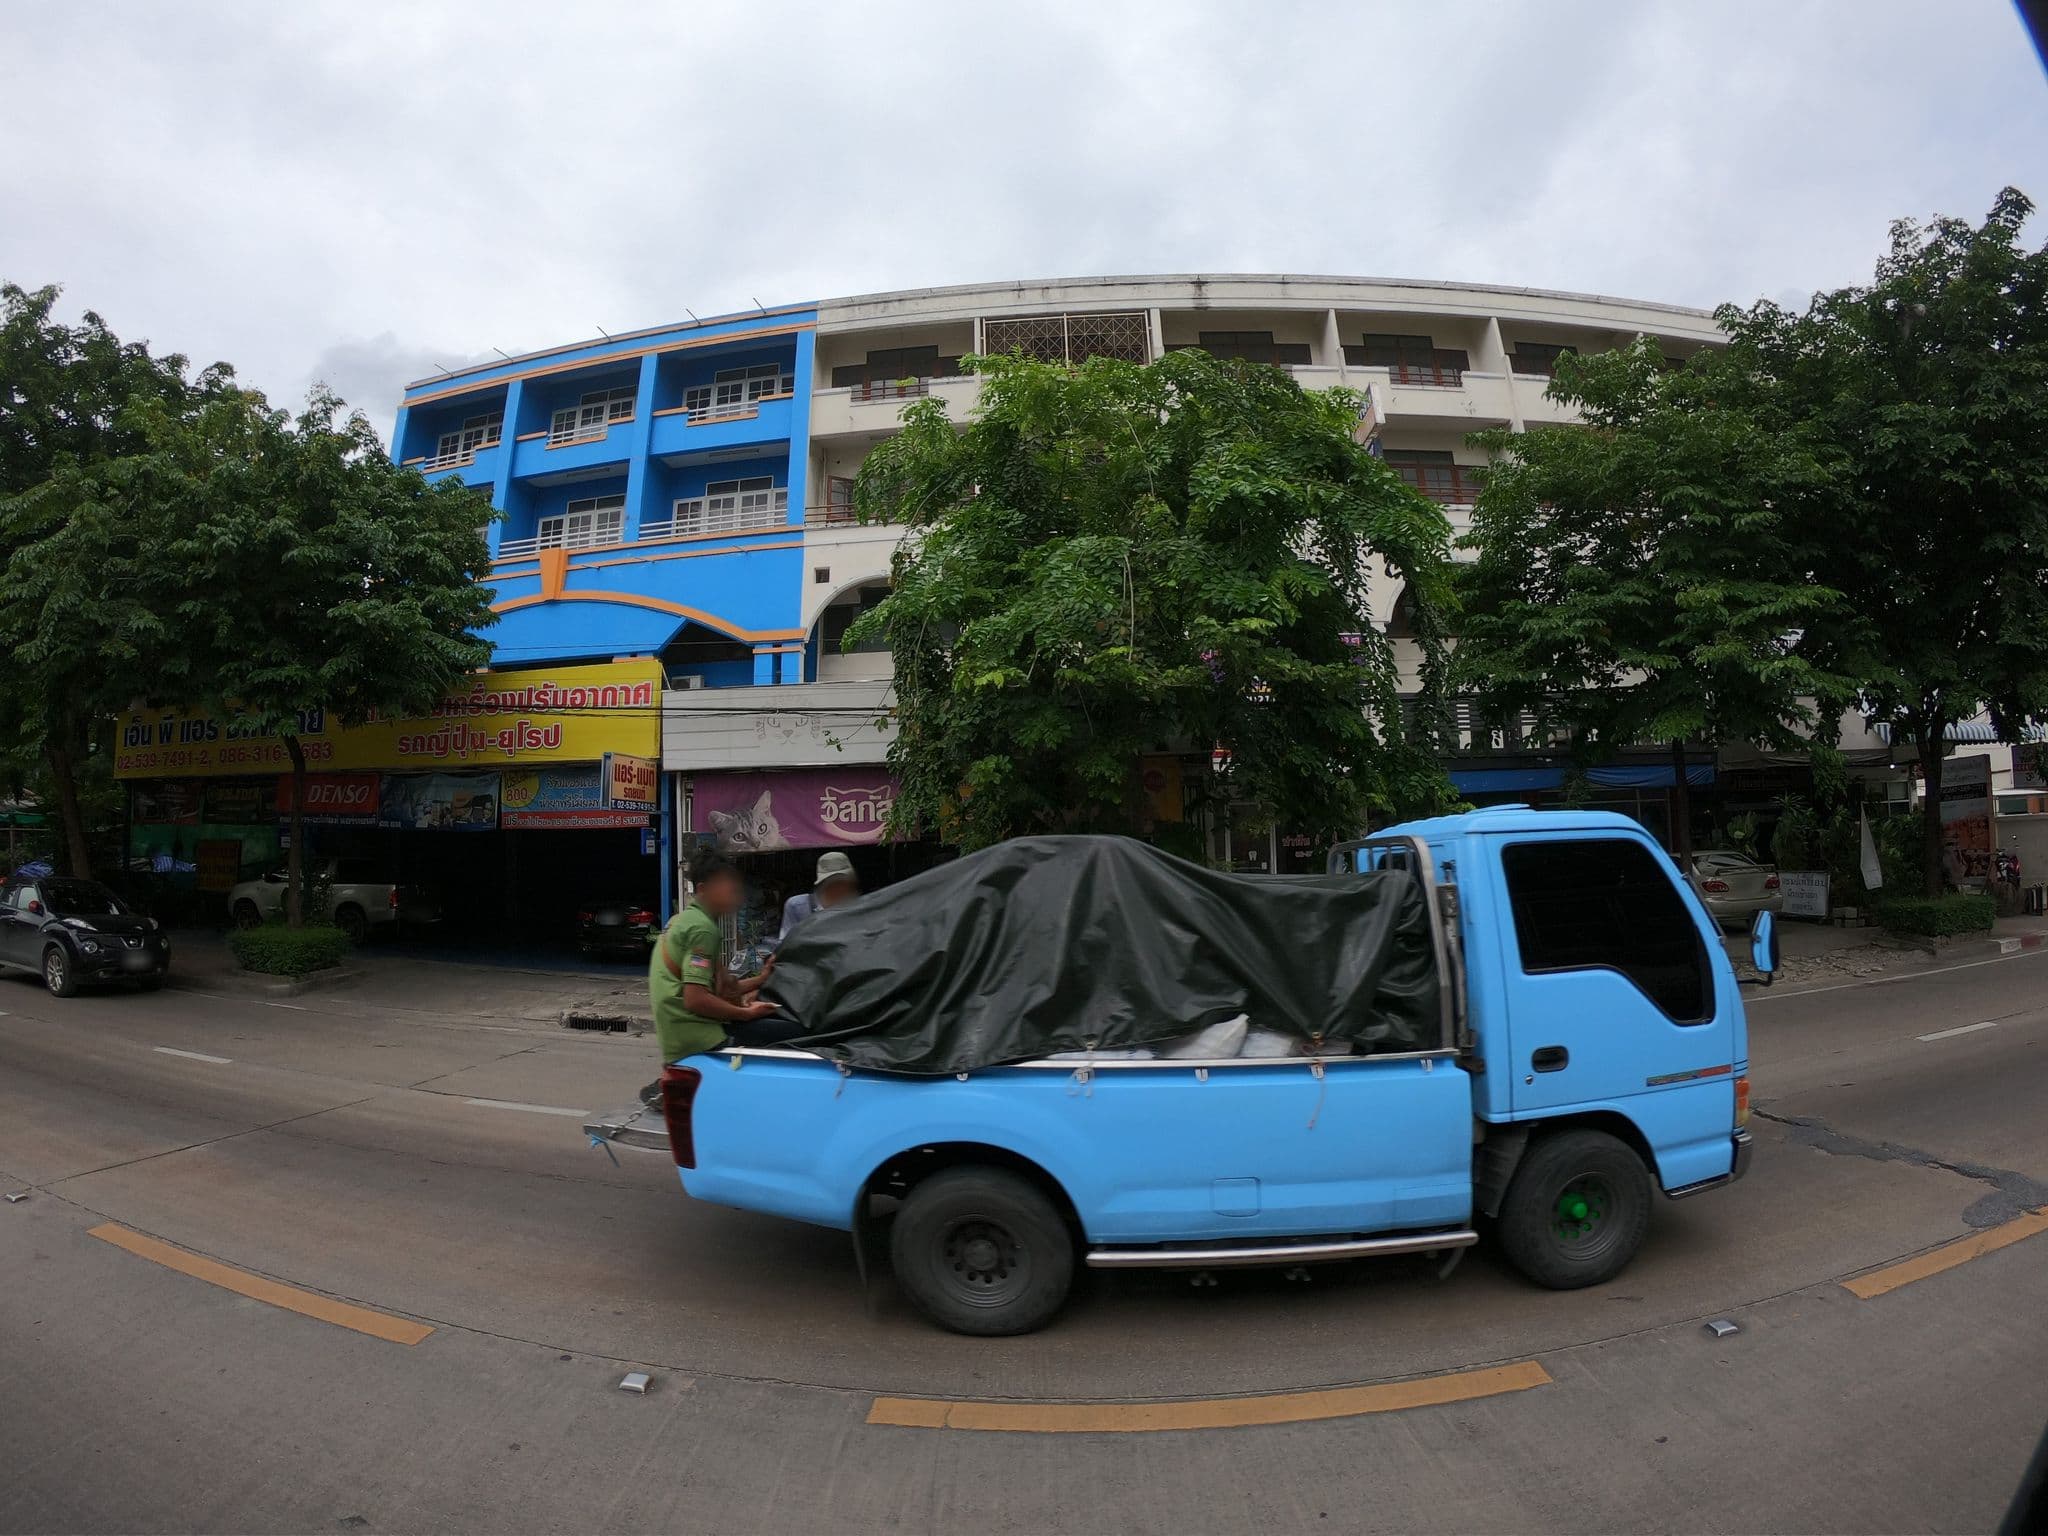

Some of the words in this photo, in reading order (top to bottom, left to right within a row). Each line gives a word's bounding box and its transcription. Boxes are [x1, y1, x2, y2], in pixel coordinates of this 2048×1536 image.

[398, 720, 561, 758] รถญี่ปุ่น-ยุโรป
[219, 742, 333, 763] 086-316-683
[307, 784, 370, 804] DENSO
